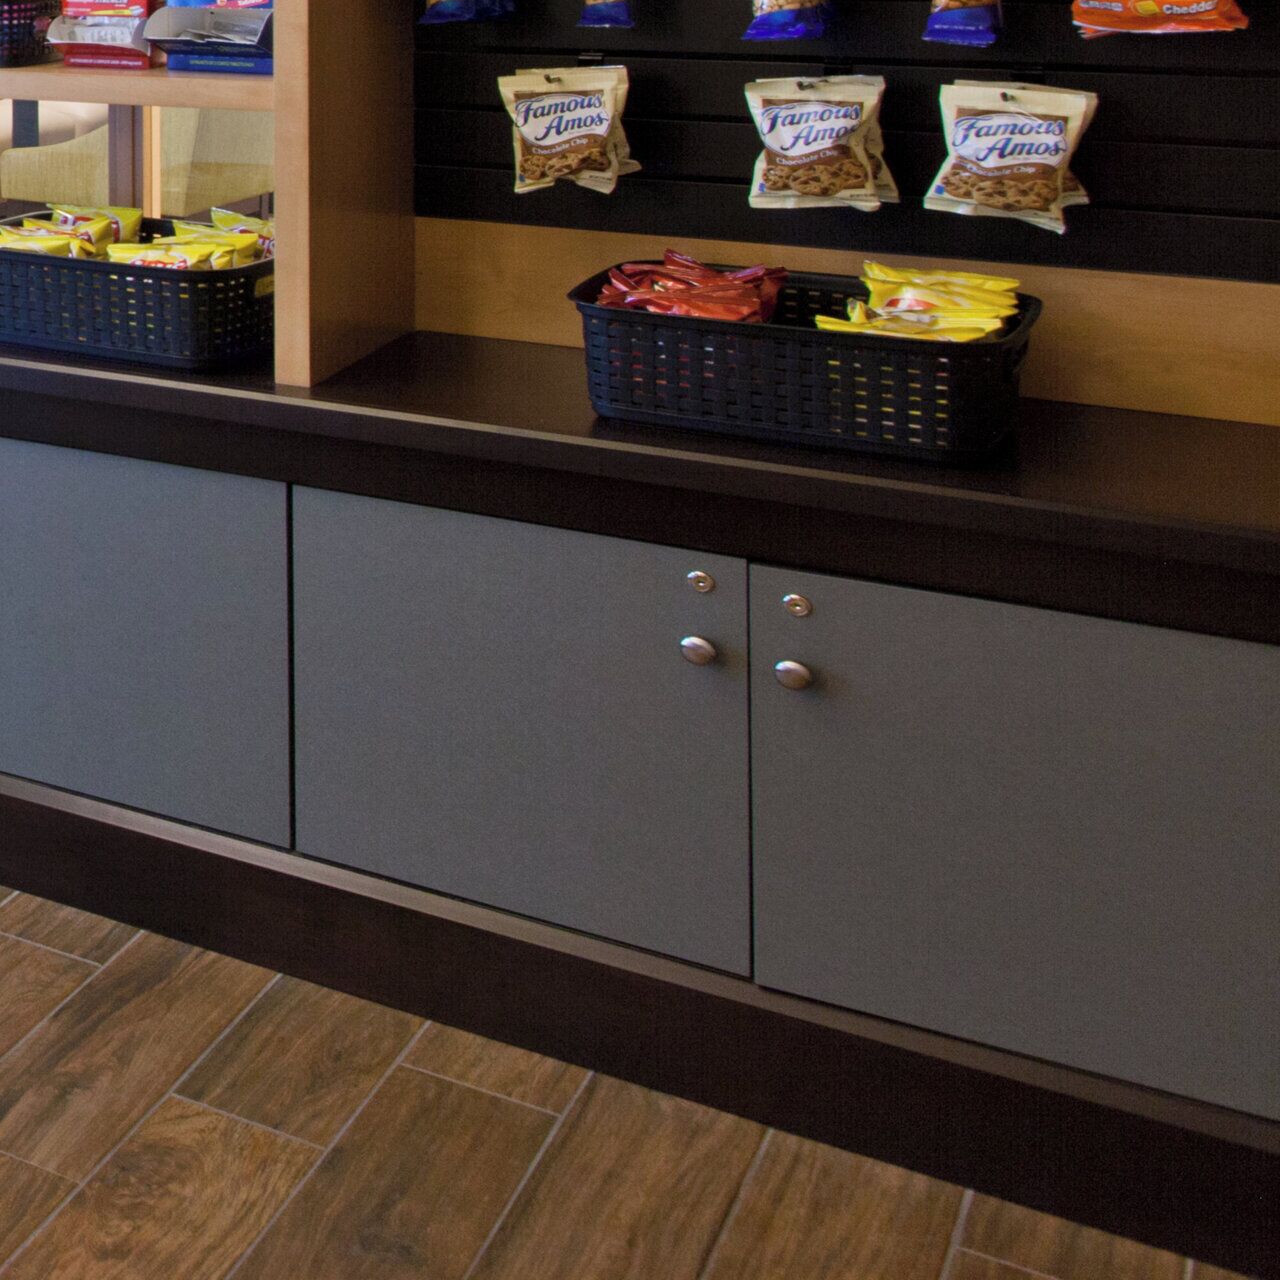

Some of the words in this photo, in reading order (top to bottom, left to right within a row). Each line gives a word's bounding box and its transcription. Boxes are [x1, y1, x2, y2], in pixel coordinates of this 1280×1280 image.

[515, 94, 603, 128] Famous
[534, 112, 609, 141] Amos
[760, 104, 861, 136] Famous
[952, 116, 1066, 147] Famous
[975, 137, 1068, 162] Amos
